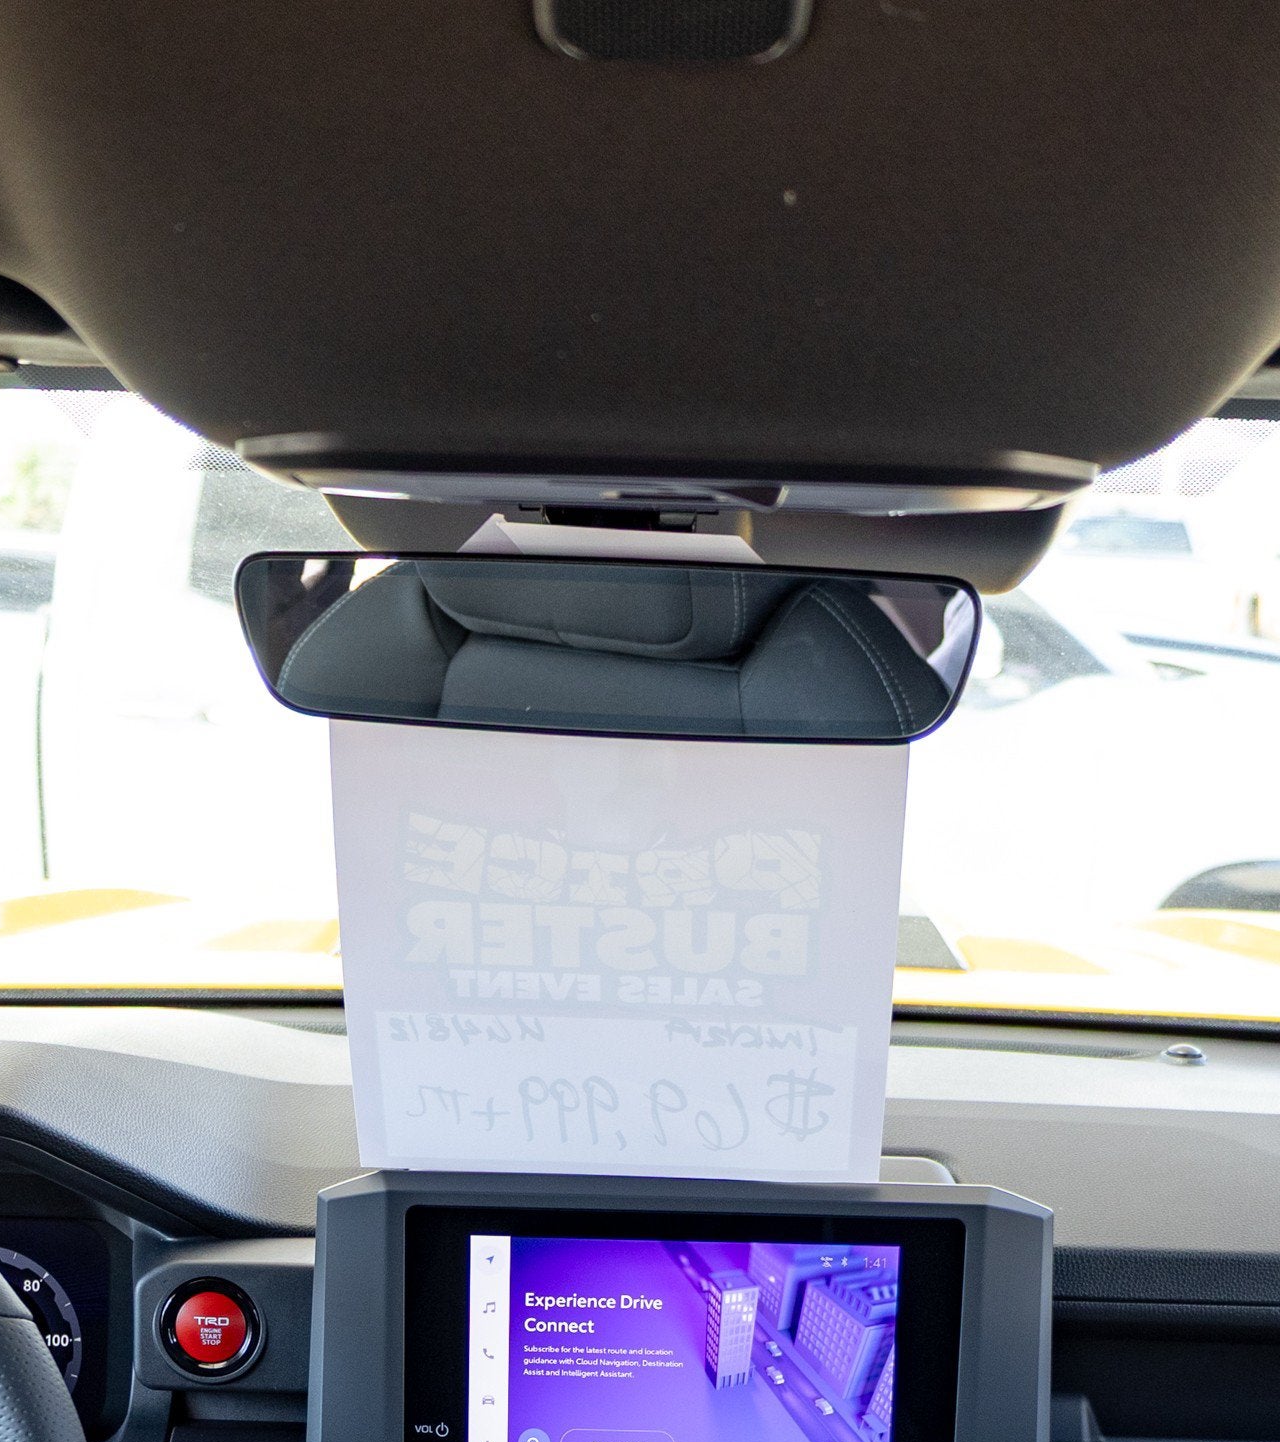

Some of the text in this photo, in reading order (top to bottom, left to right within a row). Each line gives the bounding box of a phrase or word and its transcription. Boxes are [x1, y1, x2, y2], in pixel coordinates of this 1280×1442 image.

[863, 1257, 887, 1268] 1:41
[23, 1279, 40, 1292] 80
[524, 1292, 663, 1310] Experience Drive
[193, 1316, 230, 1326] TRD
[524, 1317, 595, 1333] Connect
[45, 1334, 69, 1347] 100
[523, 1345, 559, 1353] Subscribe
[561, 1345, 571, 1353] for
[586, 1346, 606, 1354] latest
[607, 1347, 627, 1355] route
[629, 1347, 643, 1355] and
[644, 1348, 673, 1356] location
[523, 1357, 557, 1367] guidance
[576, 1358, 599, 1366] Cloud
[600, 1359, 640, 1368] Navigation,
[642, 1359, 684, 1368] Destination
[561, 1369, 598, 1379] Intelligent
[600, 1370, 634, 1378] Assistant.
[415, 1424, 434, 1435] VOL
